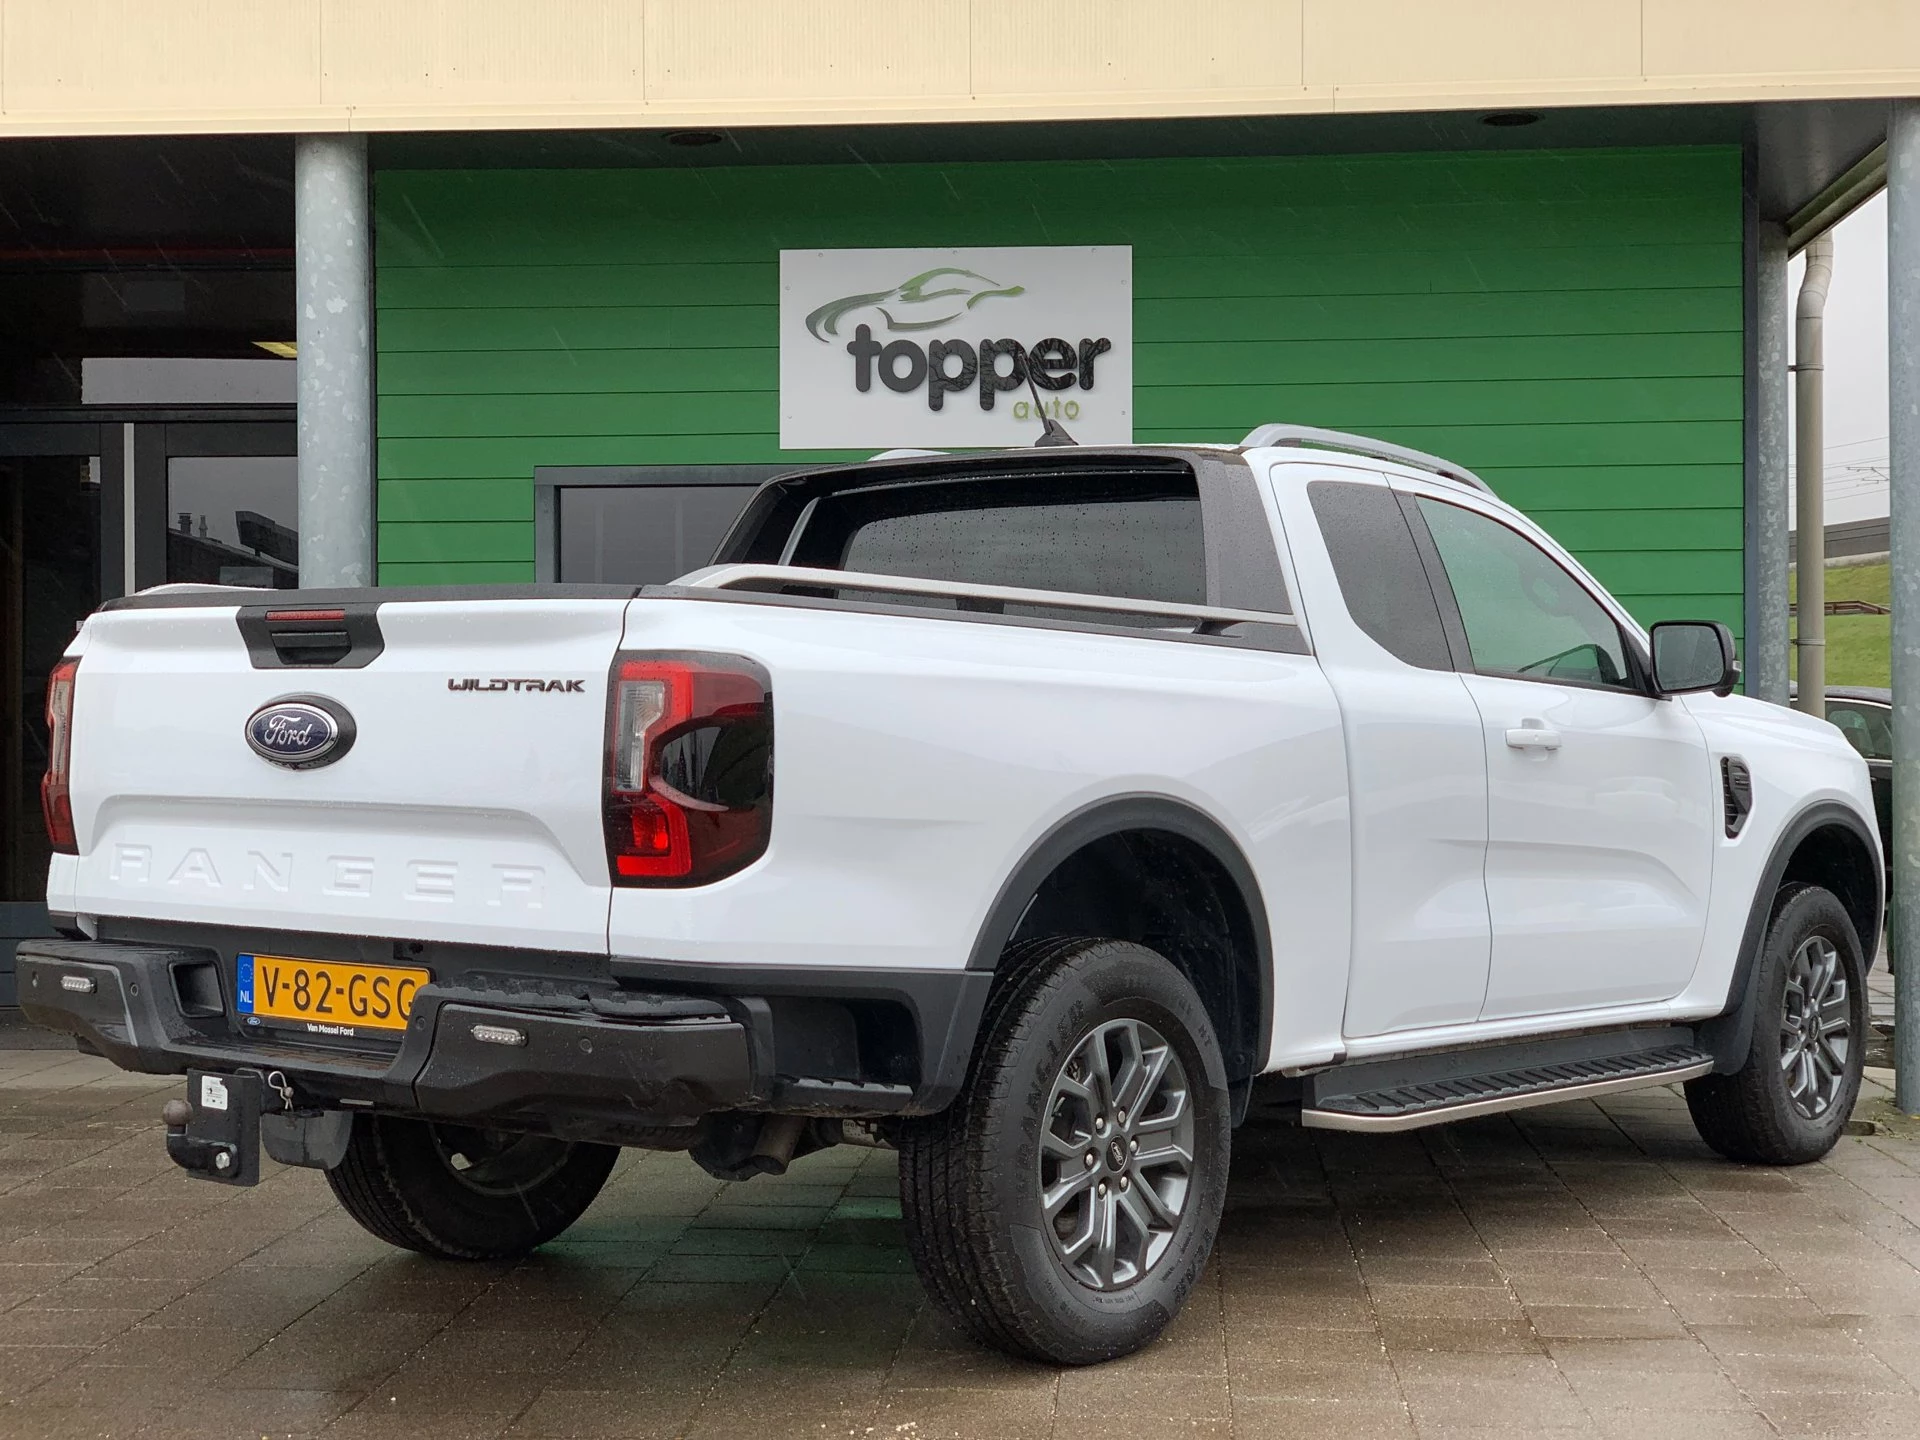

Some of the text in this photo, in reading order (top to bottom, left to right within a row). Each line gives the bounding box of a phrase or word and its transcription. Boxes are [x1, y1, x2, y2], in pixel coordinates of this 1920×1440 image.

[847, 324, 1112, 411] topper
[1013, 396, 1080, 420] auto
[447, 678, 586, 693] WILDTRAK
[264, 714, 313, 747] Ford
[109, 842, 546, 909] RANGER
[239, 989, 252, 1004] NL
[262, 965, 416, 1021] V-82-GSG
[306, 1022, 354, 1037] Van Mossel Ford
